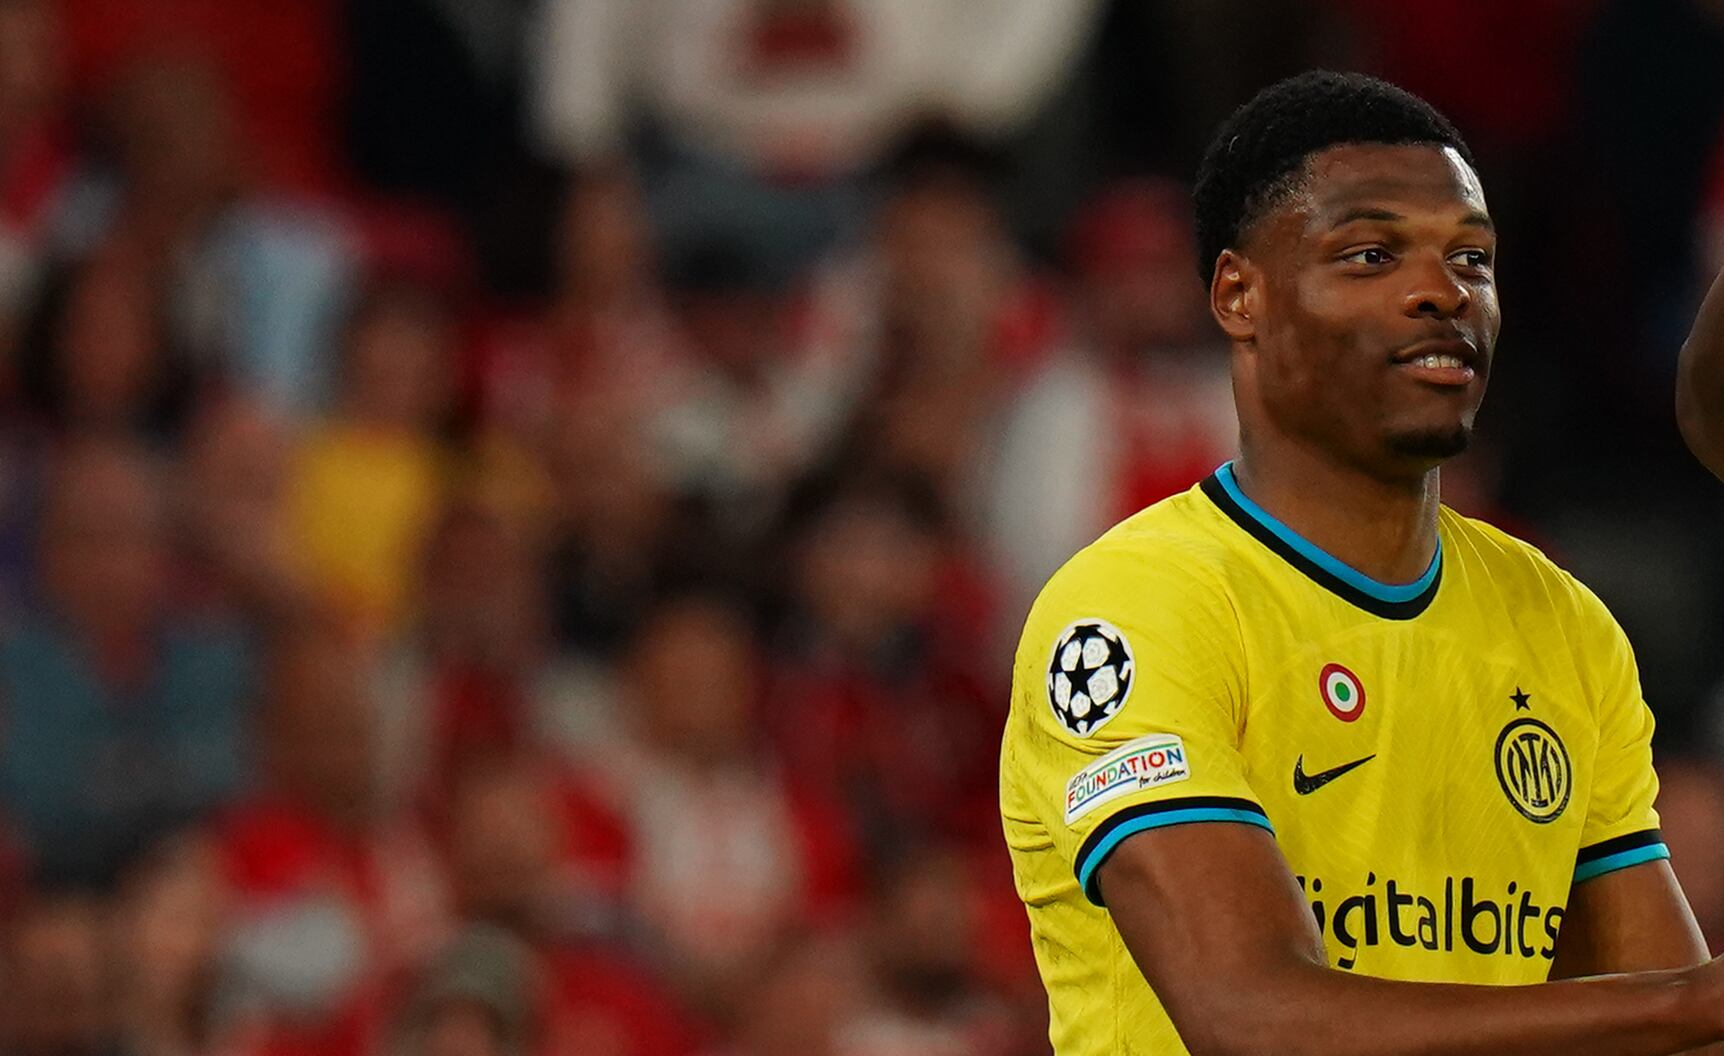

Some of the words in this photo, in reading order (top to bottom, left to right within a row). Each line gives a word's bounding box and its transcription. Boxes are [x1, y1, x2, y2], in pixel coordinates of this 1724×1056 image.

[1068, 748, 1182, 808] FOUNDATION
[1139, 776, 1150, 788] for
[1153, 769, 1186, 782] children
[1296, 872, 1565, 969] igitalbits
